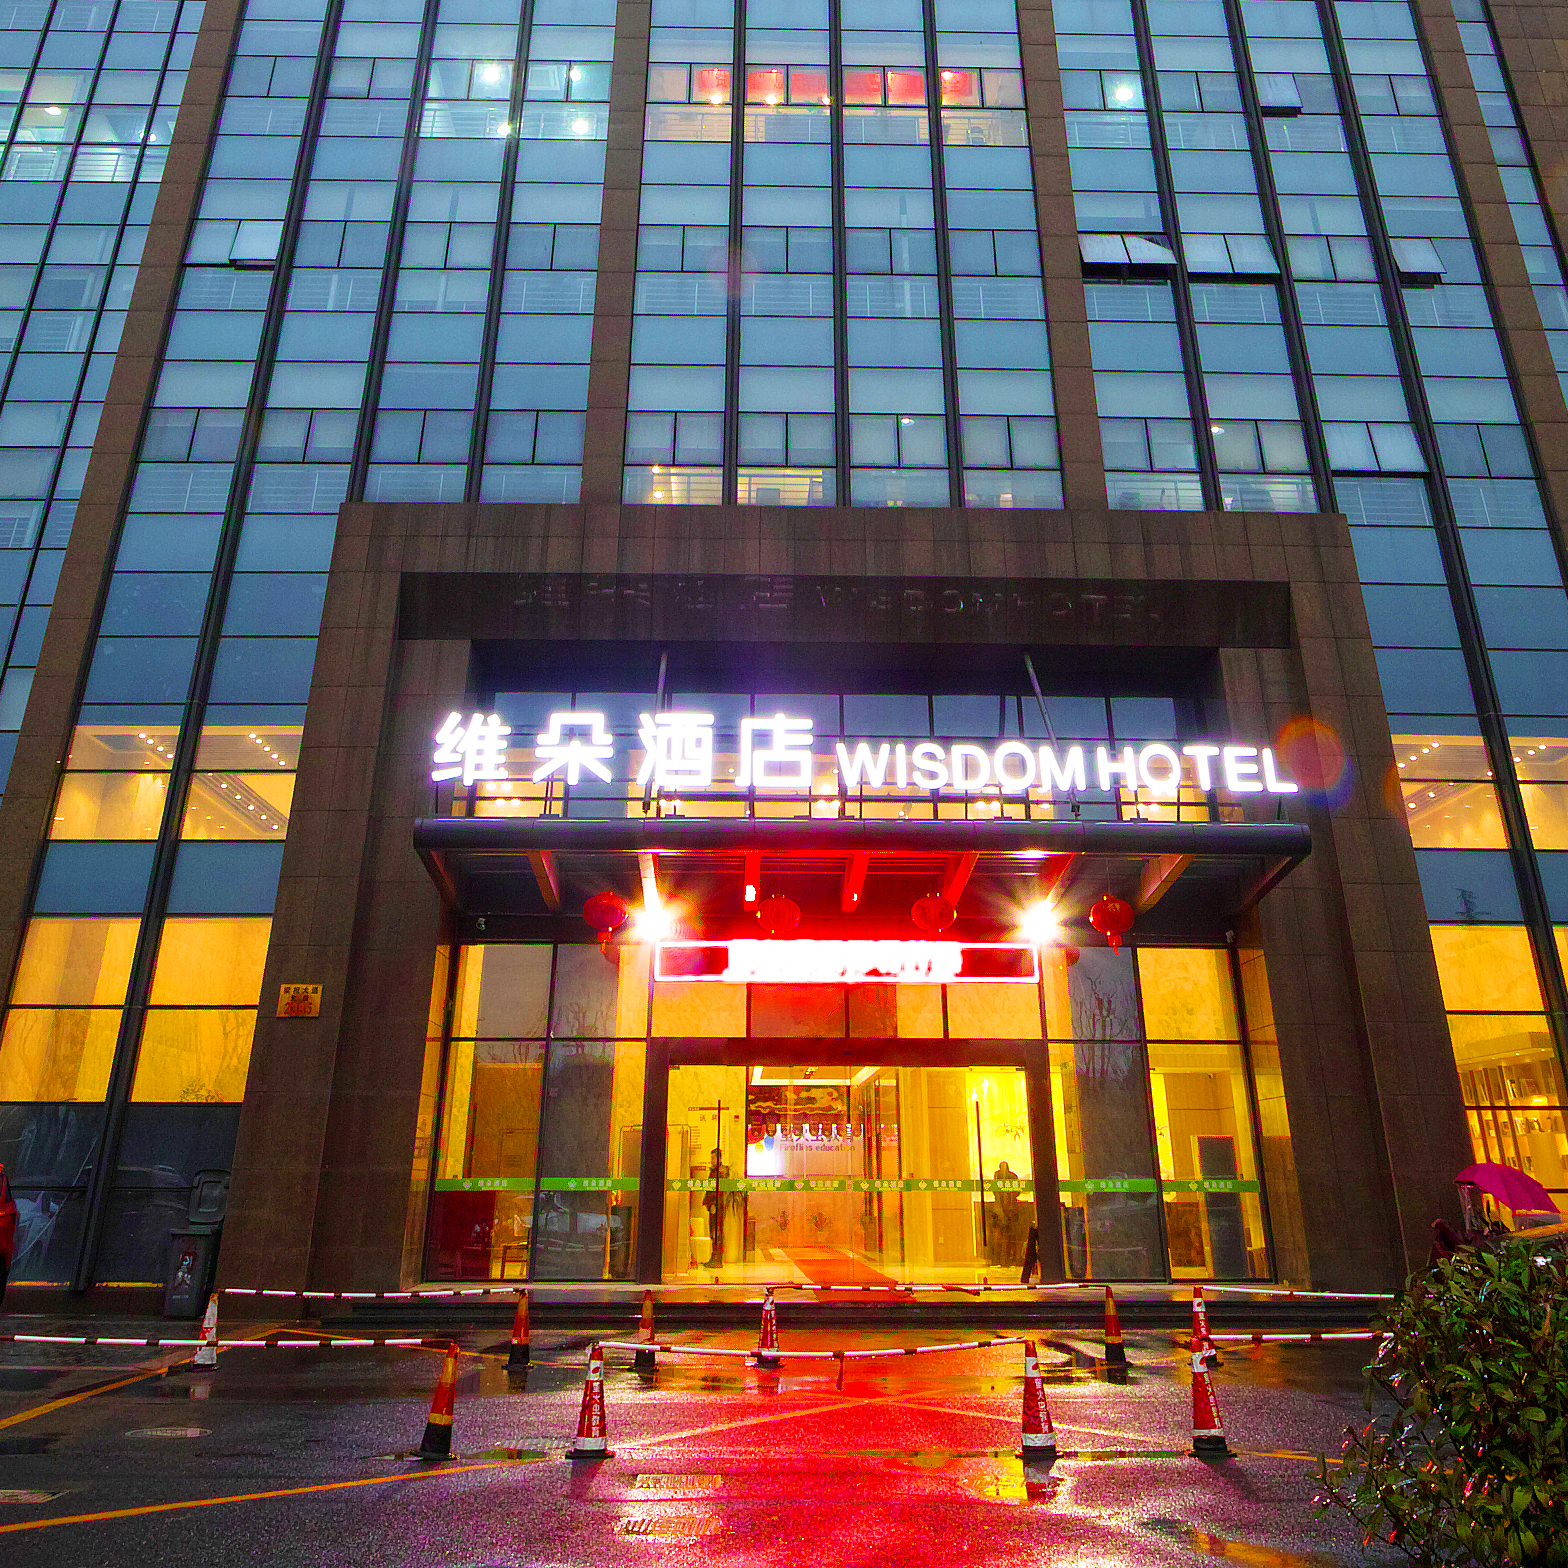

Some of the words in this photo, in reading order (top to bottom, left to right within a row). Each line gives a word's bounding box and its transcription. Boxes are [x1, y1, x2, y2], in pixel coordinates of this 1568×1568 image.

[431, 711, 814, 787] 维朵酒店
[835, 741, 1087, 792] WISDOM
[1096, 743, 1299, 793] HOTEL
